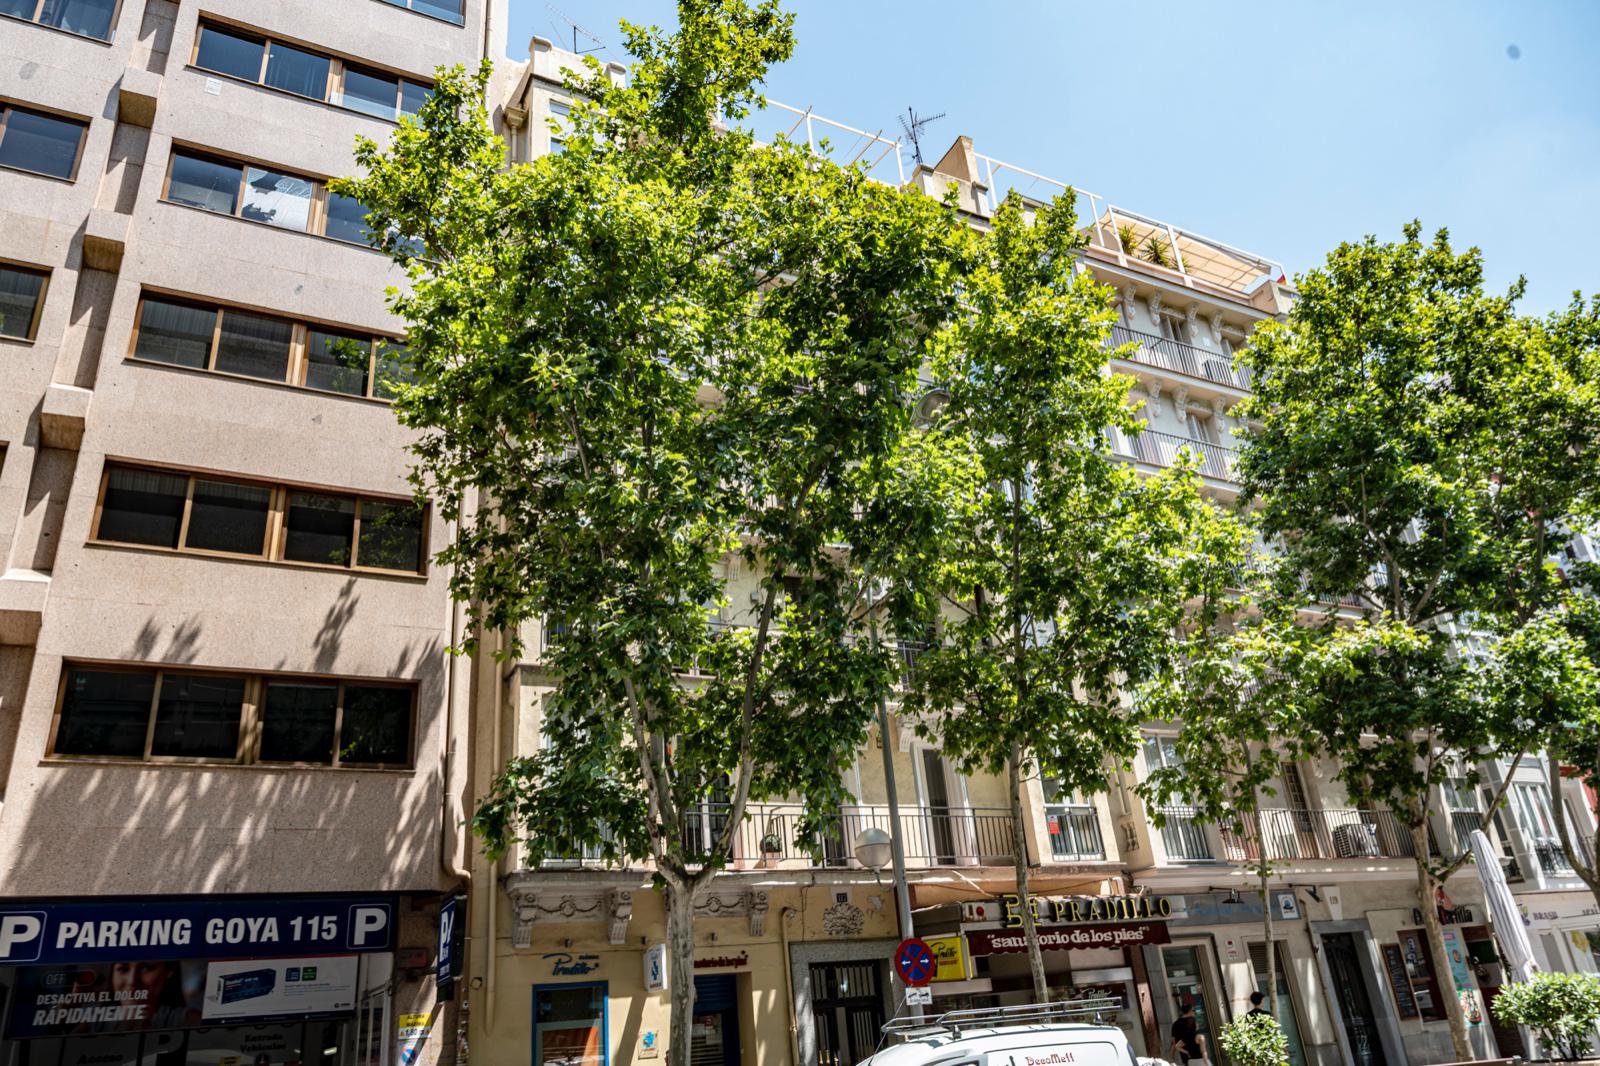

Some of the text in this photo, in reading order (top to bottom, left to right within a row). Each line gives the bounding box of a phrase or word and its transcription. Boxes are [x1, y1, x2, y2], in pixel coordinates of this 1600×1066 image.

[1054, 896, 1173, 923] PRADILLO
[0, 916, 41, 958] P
[56, 915, 338, 949] PARKING GOYA 115
[353, 907, 387, 946] P
[987, 932, 1070, 949] "sanorio
[1070, 929, 1090, 944] de
[1091, 929, 1113, 943] los
[36, 989, 149, 1006] DESACTIVA EL DOLOR
[32, 1003, 148, 1027] RÁPIDAMENTE
